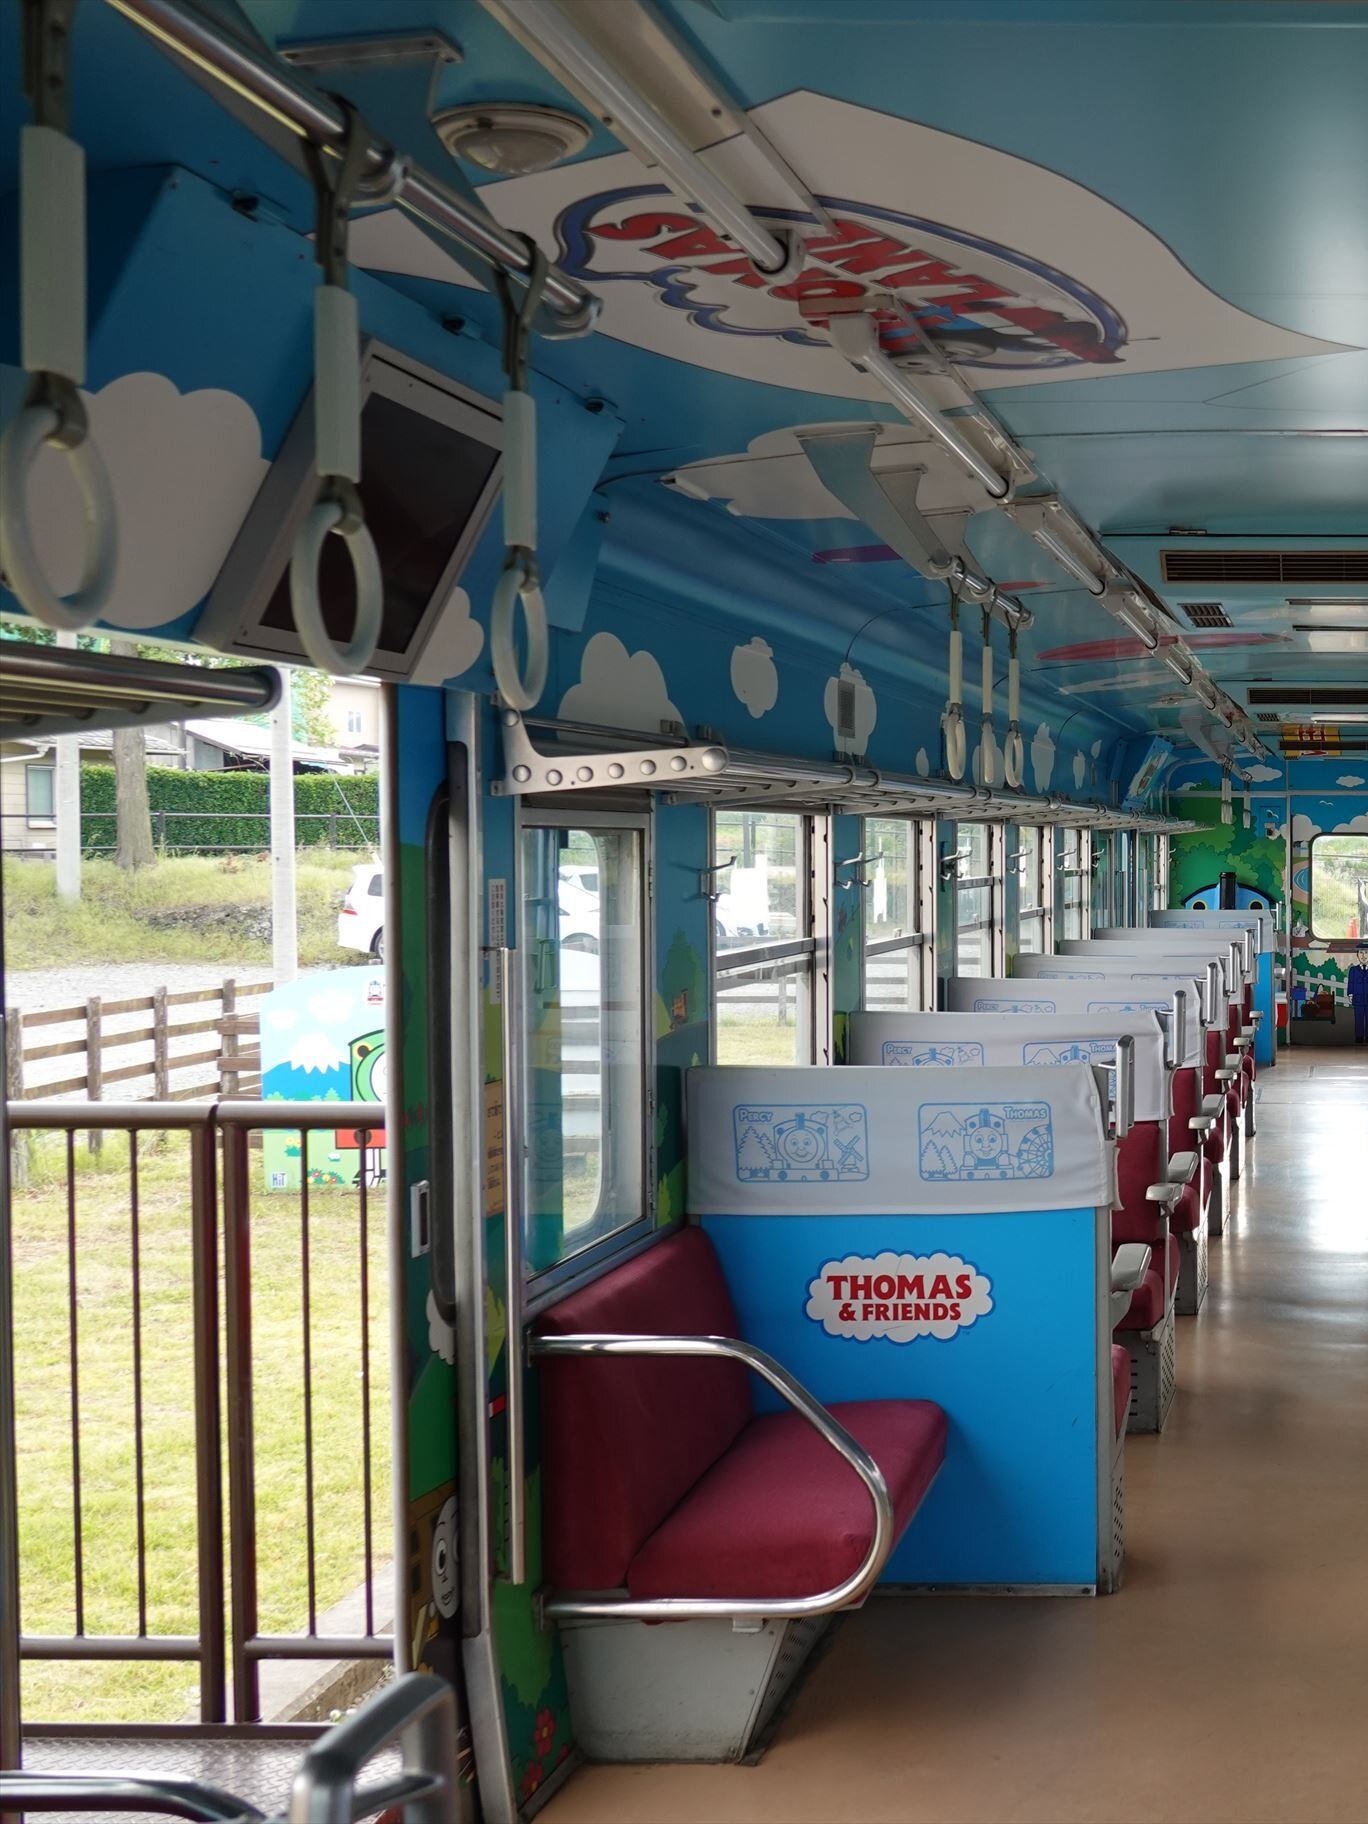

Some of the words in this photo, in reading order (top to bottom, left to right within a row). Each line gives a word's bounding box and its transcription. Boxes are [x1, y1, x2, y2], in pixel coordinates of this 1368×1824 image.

[738, 1109, 773, 1123] PERCY
[1003, 1106, 1047, 1120] THOMAS
[826, 1273, 972, 1301] THOMAS
[838, 1302, 857, 1322] &
[863, 1302, 961, 1321] FRIENDS
